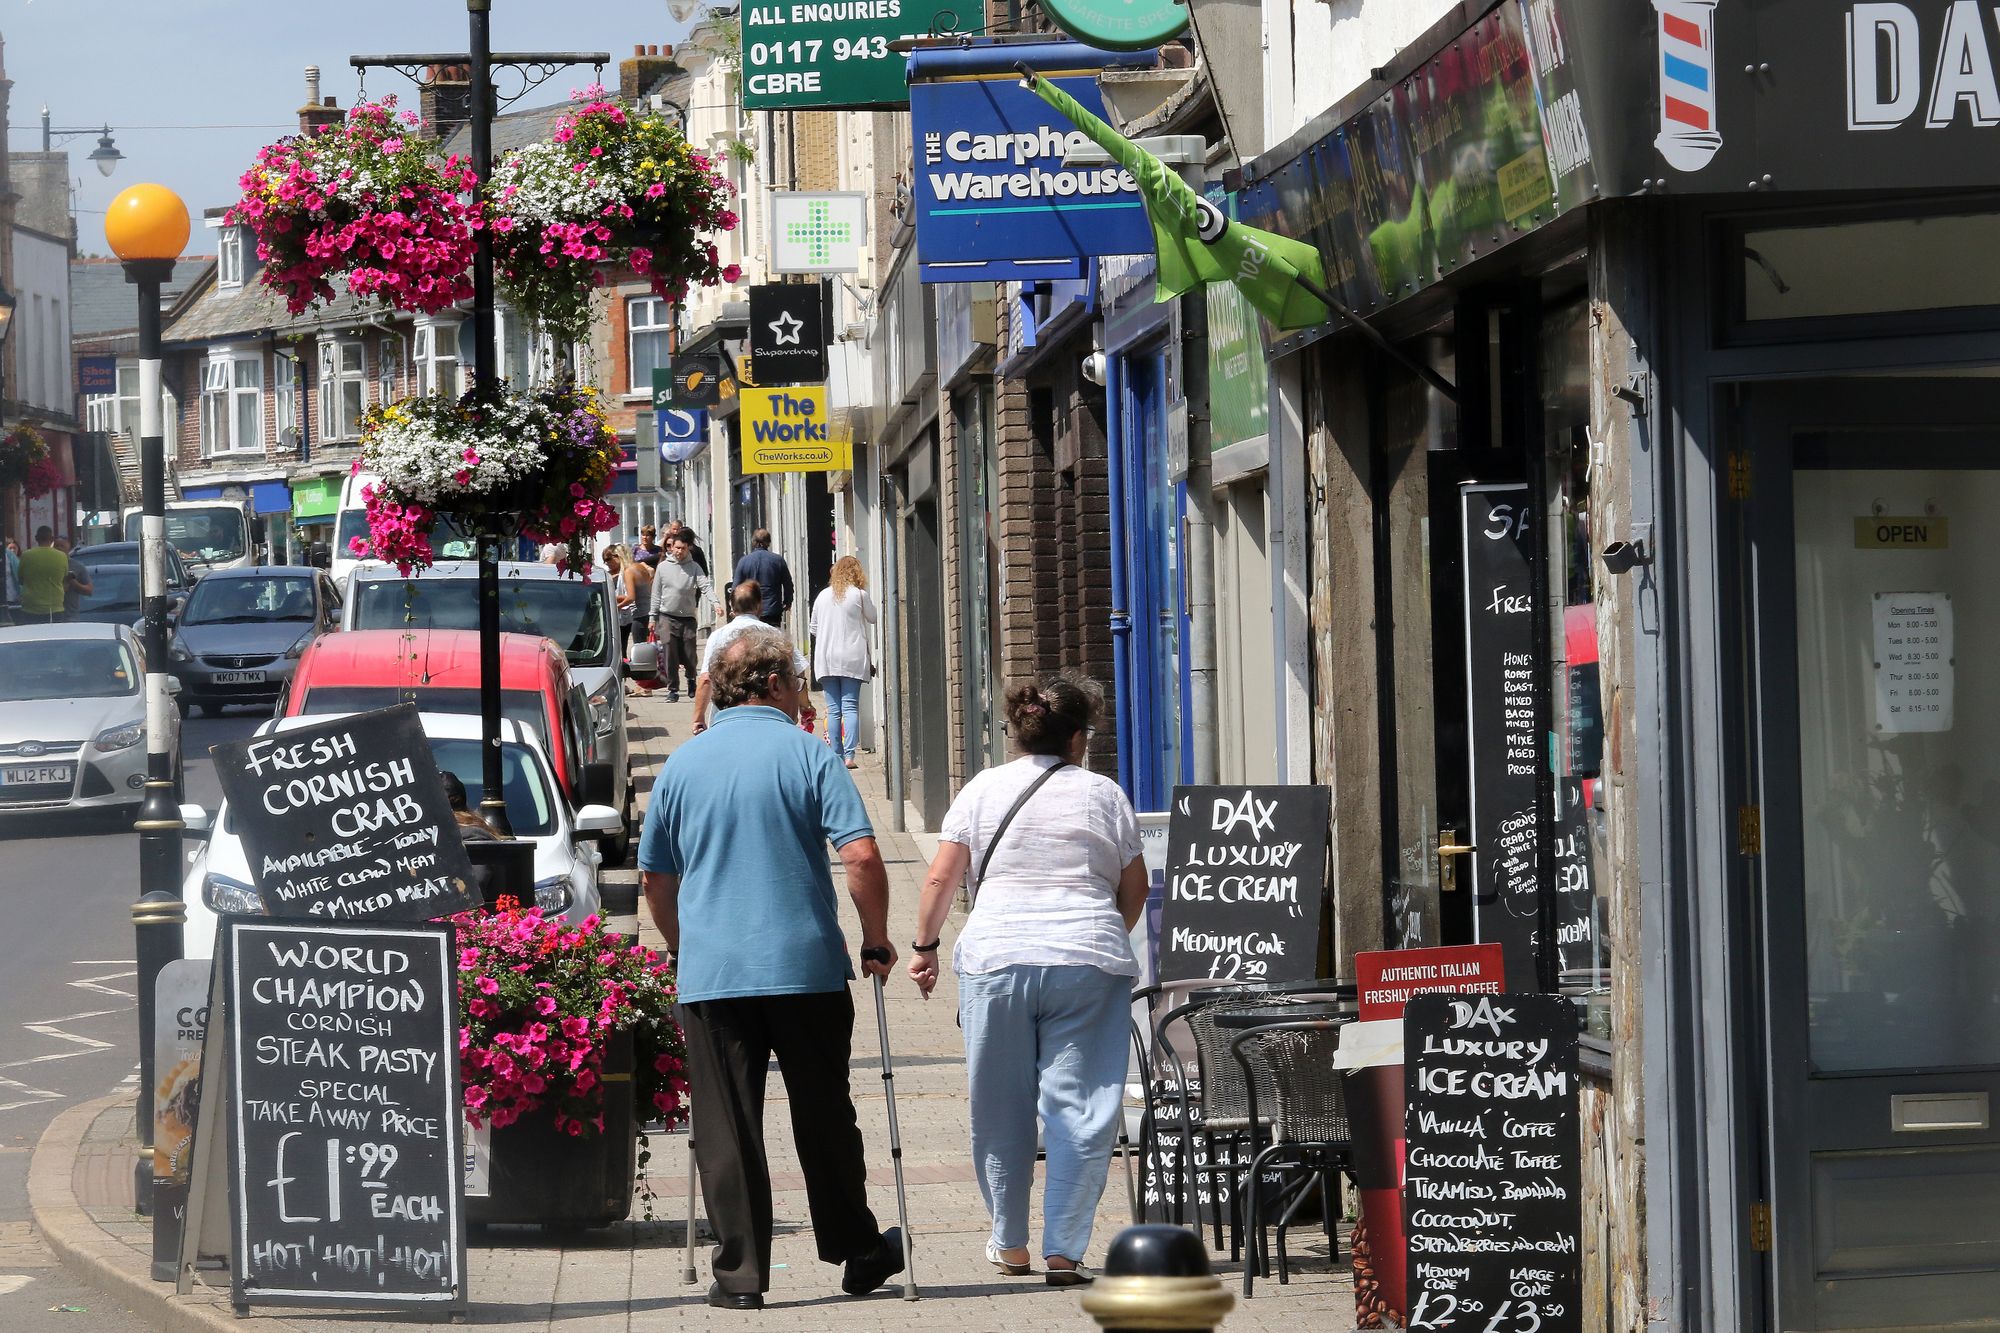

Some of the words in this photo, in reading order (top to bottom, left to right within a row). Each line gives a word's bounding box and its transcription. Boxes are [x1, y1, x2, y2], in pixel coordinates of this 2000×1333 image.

[749, 7, 785, 25] ALL
[792, 0, 900, 22] ENQUIRIES
[750, 40, 823, 65] 0117
[833, 36, 888, 61] 943
[1846, 0, 2000, 130] DA
[749, 72, 821, 94] CBRE
[926, 132, 941, 165] THE
[946, 126, 1092, 165] Carpho
[929, 168, 1138, 200] Warehouse
[754, 347, 819, 357] Superdrug
[656, 388, 672, 404] SU
[768, 393, 815, 416] The
[752, 418, 828, 444] Works
[758, 451, 829, 461] TheWorks.co.uk
[1876, 525, 1927, 543] OPEN
[1485, 585, 1531, 614] FRE
[1891, 606, 1915, 615] Opening
[1925, 636, 1938, 644] 5.00
[1503, 652, 1532, 665] HONE
[1925, 652, 1938, 660] 5.00
[216, 672, 240, 681] WK07
[1504, 669, 1532, 679] ROAST
[1926, 672, 1939, 680] 5.00
[1505, 694, 1532, 706] MIXED
[1507, 733, 1535, 745] MIXE
[245, 733, 357, 777] FRESH
[1507, 748, 1535, 759] AGED
[7, 770, 35, 782] WL12
[40, 768, 66, 780] FKJ
[263, 757, 416, 815] CORNISH
[332, 794, 423, 837] CRAB
[1212, 790, 1279, 842] DAX
[1502, 813, 1536, 833] CORNIS
[1501, 832, 1524, 847] CRAB
[1508, 842, 1531, 856] WHITE
[263, 837, 371, 878] AVAILABLE
[385, 826, 438, 852] TODAY
[1186, 841, 1302, 869] LUXURY
[275, 876, 331, 901] WHITE
[338, 858, 391, 887] CLAW
[396, 853, 436, 873] MEAT
[1171, 866, 1214, 901] ICE
[1219, 875, 1297, 903] CREAM
[324, 893, 393, 919] MIXED
[397, 876, 450, 902] MEAT
[1171, 927, 1242, 954] MEDIUM
[1244, 932, 1286, 956] CONE
[268, 941, 409, 975] WORLD
[1381, 965, 1438, 982] AUTHENTIC
[1441, 962, 1480, 977] ITALIAN
[252, 977, 425, 1012] CHAMPION
[1365, 988, 1410, 1004] FRESHLY
[1460, 981, 1499, 995] COFFEE
[177, 1007, 208, 1028] CO
[287, 1012, 391, 1037] CORNISH
[1449, 997, 1517, 1037] DAX
[178, 1030, 204, 1040] PRE
[256, 1036, 350, 1070] STEAK
[359, 1045, 436, 1084] PASTY
[1423, 1035, 1548, 1066] LUXURY
[299, 1080, 400, 1105] SPECIAL
[1418, 1066, 1467, 1096] ICE
[1471, 1068, 1567, 1100] CREAM
[246, 1100, 304, 1125] TAKE
[381, 1108, 439, 1139] PRICE
[1510, 1150, 1562, 1170] TOFFEE
[371, 1193, 444, 1223] EACH
[1410, 1232, 1511, 1253] STRAWBERRIES
[1511, 1236, 1534, 1252] AND
[1535, 1231, 1575, 1254] CREAM
[1417, 1262, 1471, 1282] MEDIUM
[1424, 1277, 1458, 1290] CONE
[1510, 1267, 1555, 1282] LARGE
[1510, 1281, 1551, 1298] CONE
